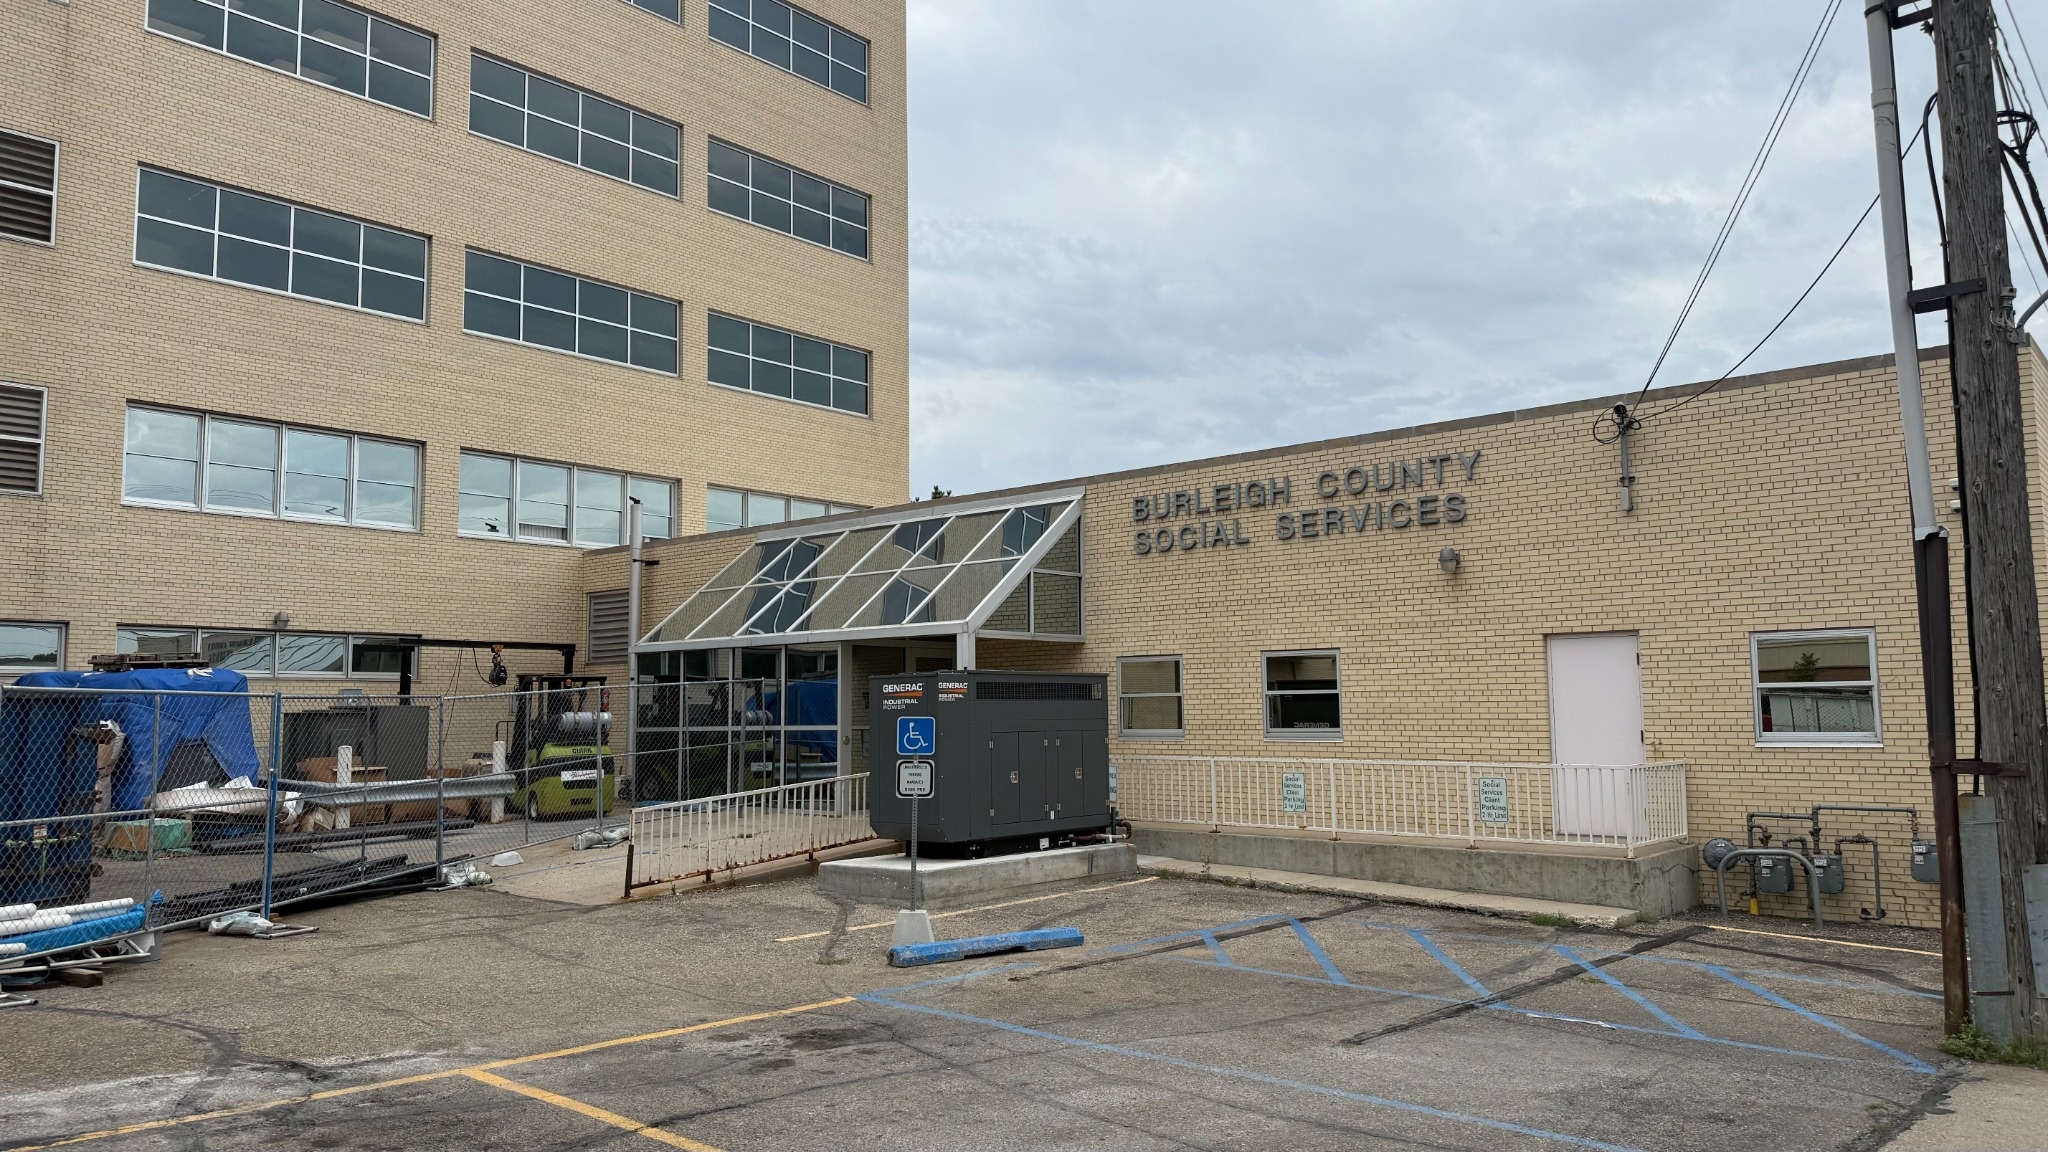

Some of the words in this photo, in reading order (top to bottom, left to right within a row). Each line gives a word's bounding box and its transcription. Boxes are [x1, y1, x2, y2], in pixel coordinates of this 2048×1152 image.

[1133, 476, 1291, 521] BURLEIGH
[1316, 450, 1481, 498] COUNTY
[1134, 518, 1250, 554] SOCIAL
[1275, 493, 1468, 540] SERVICES
[882, 683, 923, 693] GENERAC
[1482, 804, 1506, 812] Parking
